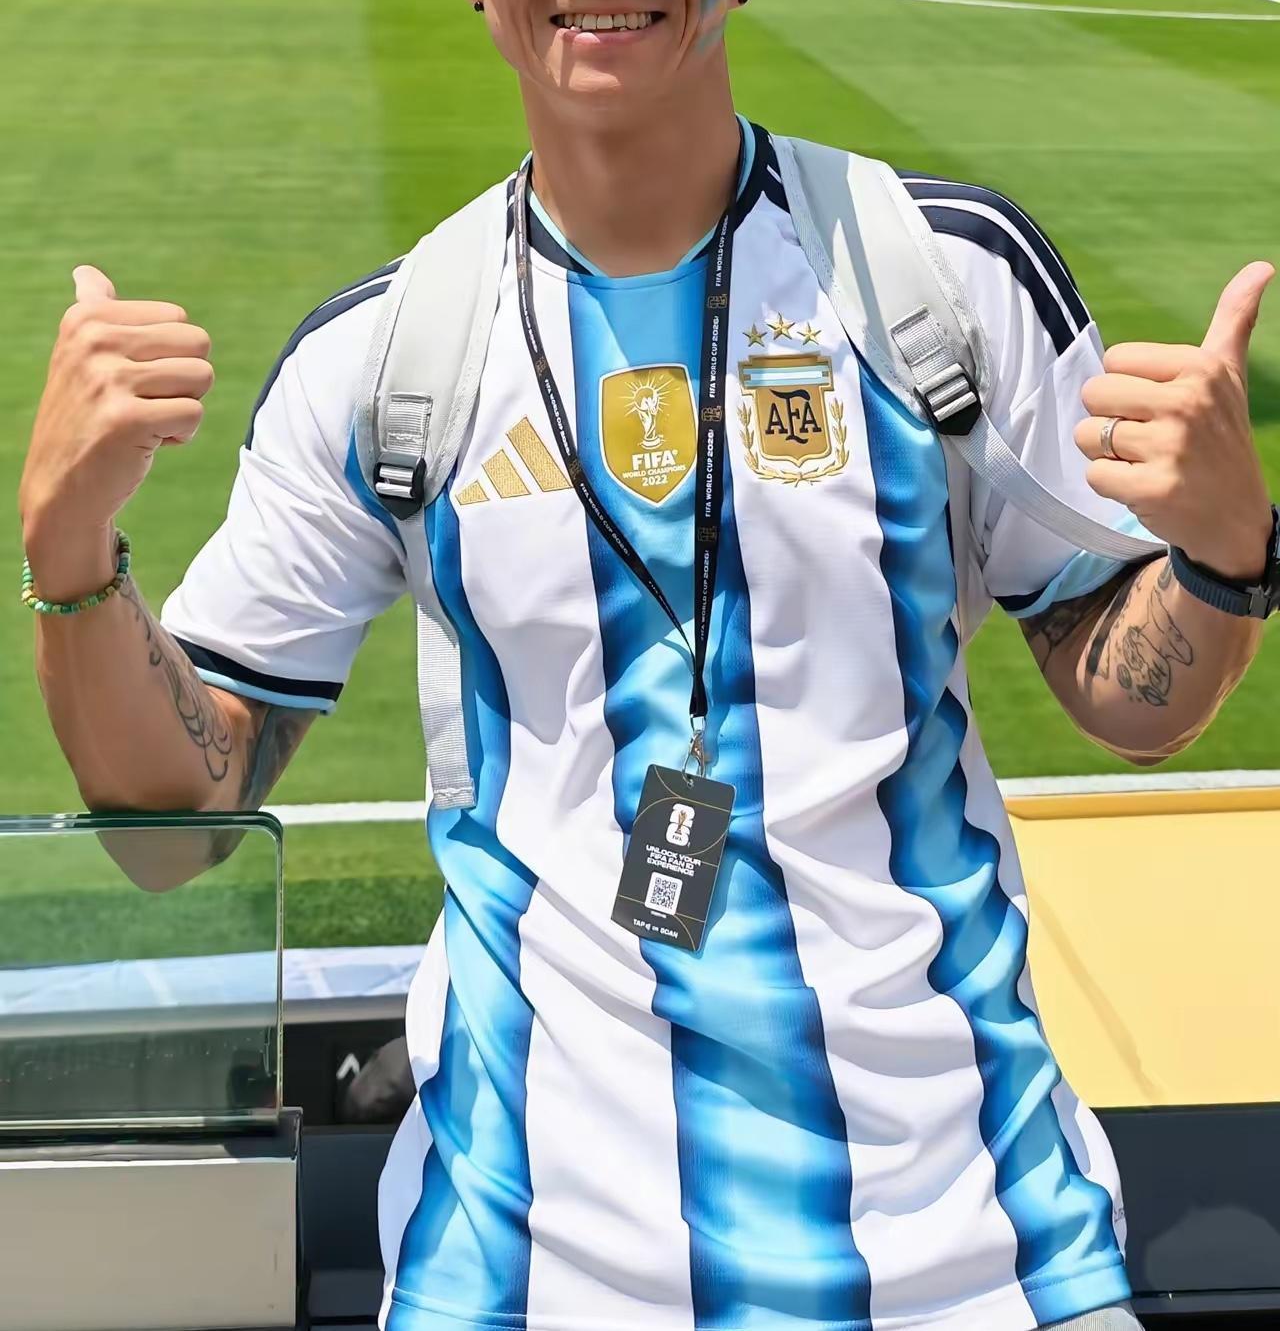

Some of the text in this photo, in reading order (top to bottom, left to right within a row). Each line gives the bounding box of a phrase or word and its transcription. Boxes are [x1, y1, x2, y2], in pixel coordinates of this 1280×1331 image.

[716, 248, 724, 272] WORLD
[549, 394, 560, 419] WORLD
[556, 416, 564, 431] CUP
[765, 388, 822, 444] AFA
[622, 465, 686, 479] WORLD CHAMPIONS
[642, 475, 668, 487] 2022
[588, 497, 604, 522] WORLD
[602, 519, 613, 535] CUP
[646, 844, 702, 867] UNLOCK YOUR
[650, 852, 694, 870] FIFA FAN ID
[647, 857, 695, 877] EXPERIENCE
[633, 918, 645, 927] TAP
[660, 927, 679, 939] SCAN
